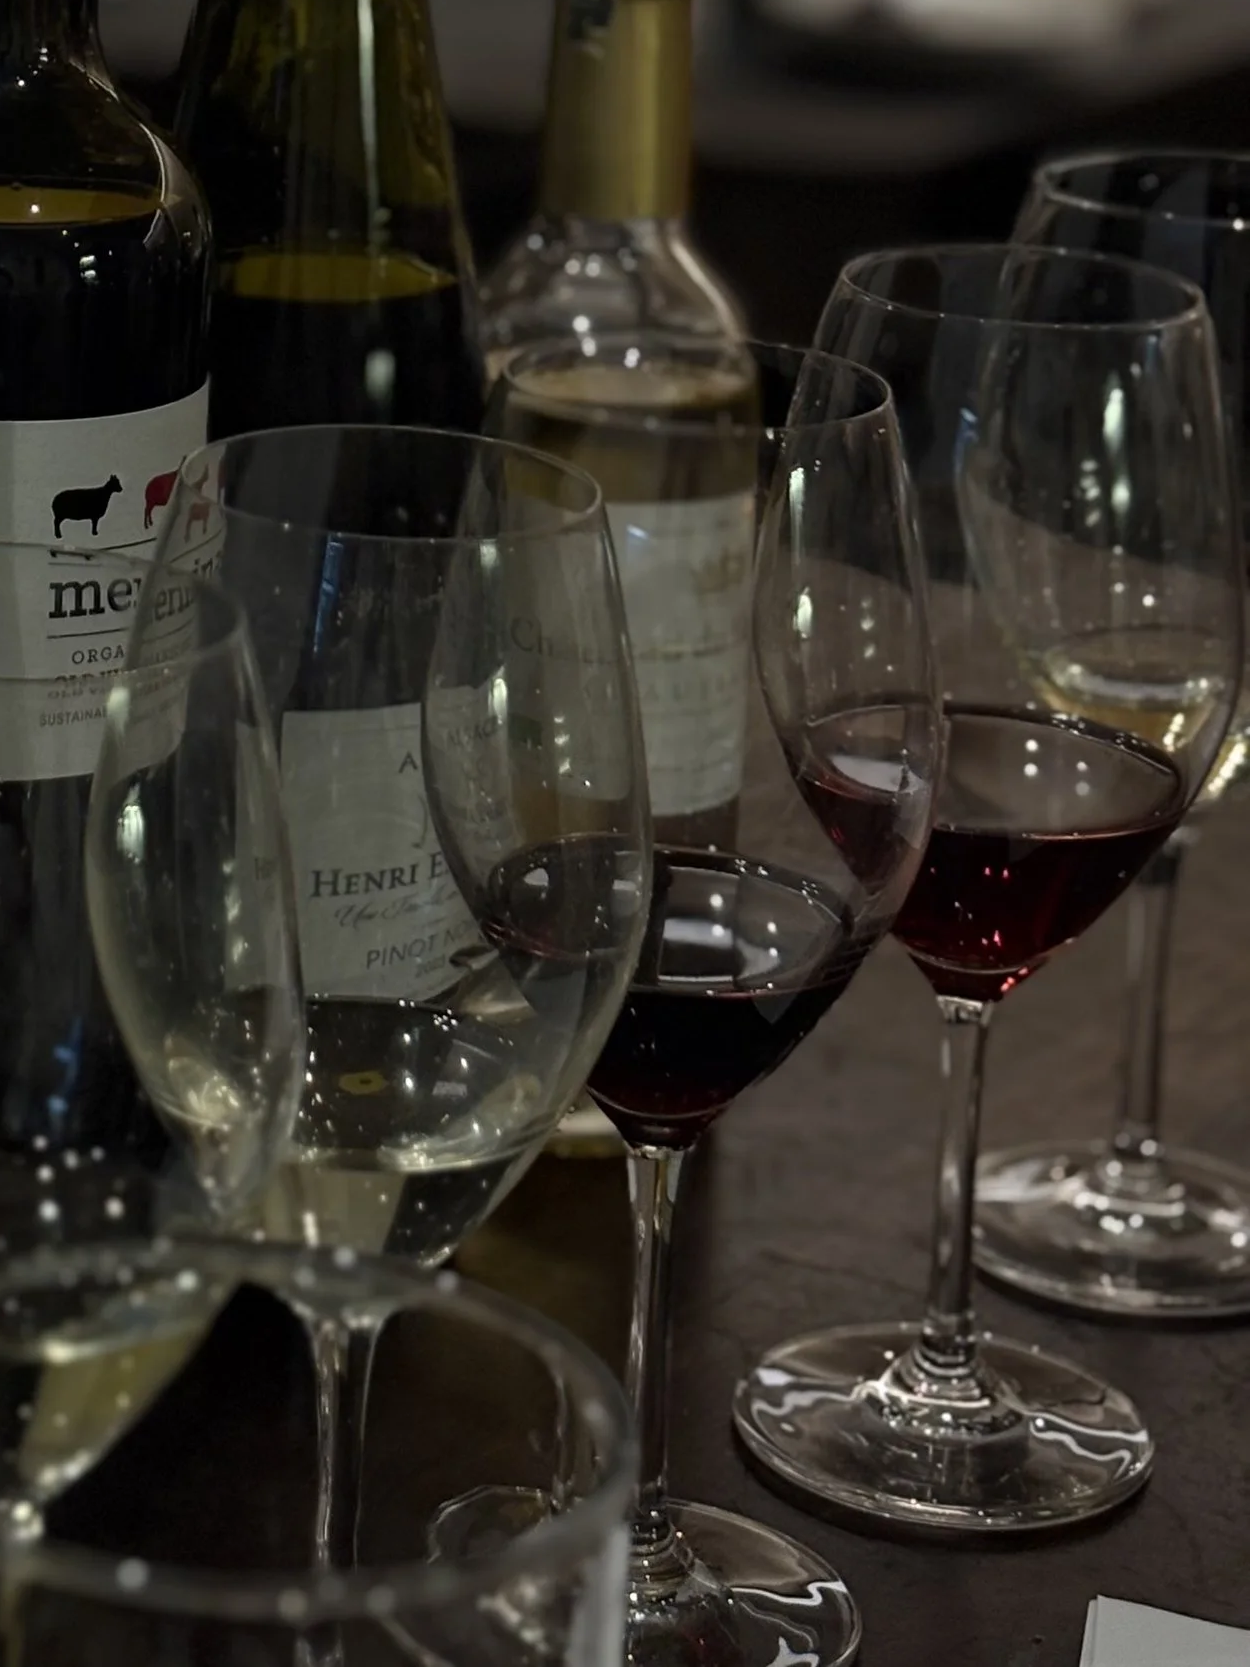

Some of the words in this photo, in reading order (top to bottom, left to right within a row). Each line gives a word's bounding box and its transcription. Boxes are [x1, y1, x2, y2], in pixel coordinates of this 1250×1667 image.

[71, 644, 125, 665] ORGA
[310, 863, 419, 898] HENRI
[366, 933, 436, 969] PINOT
